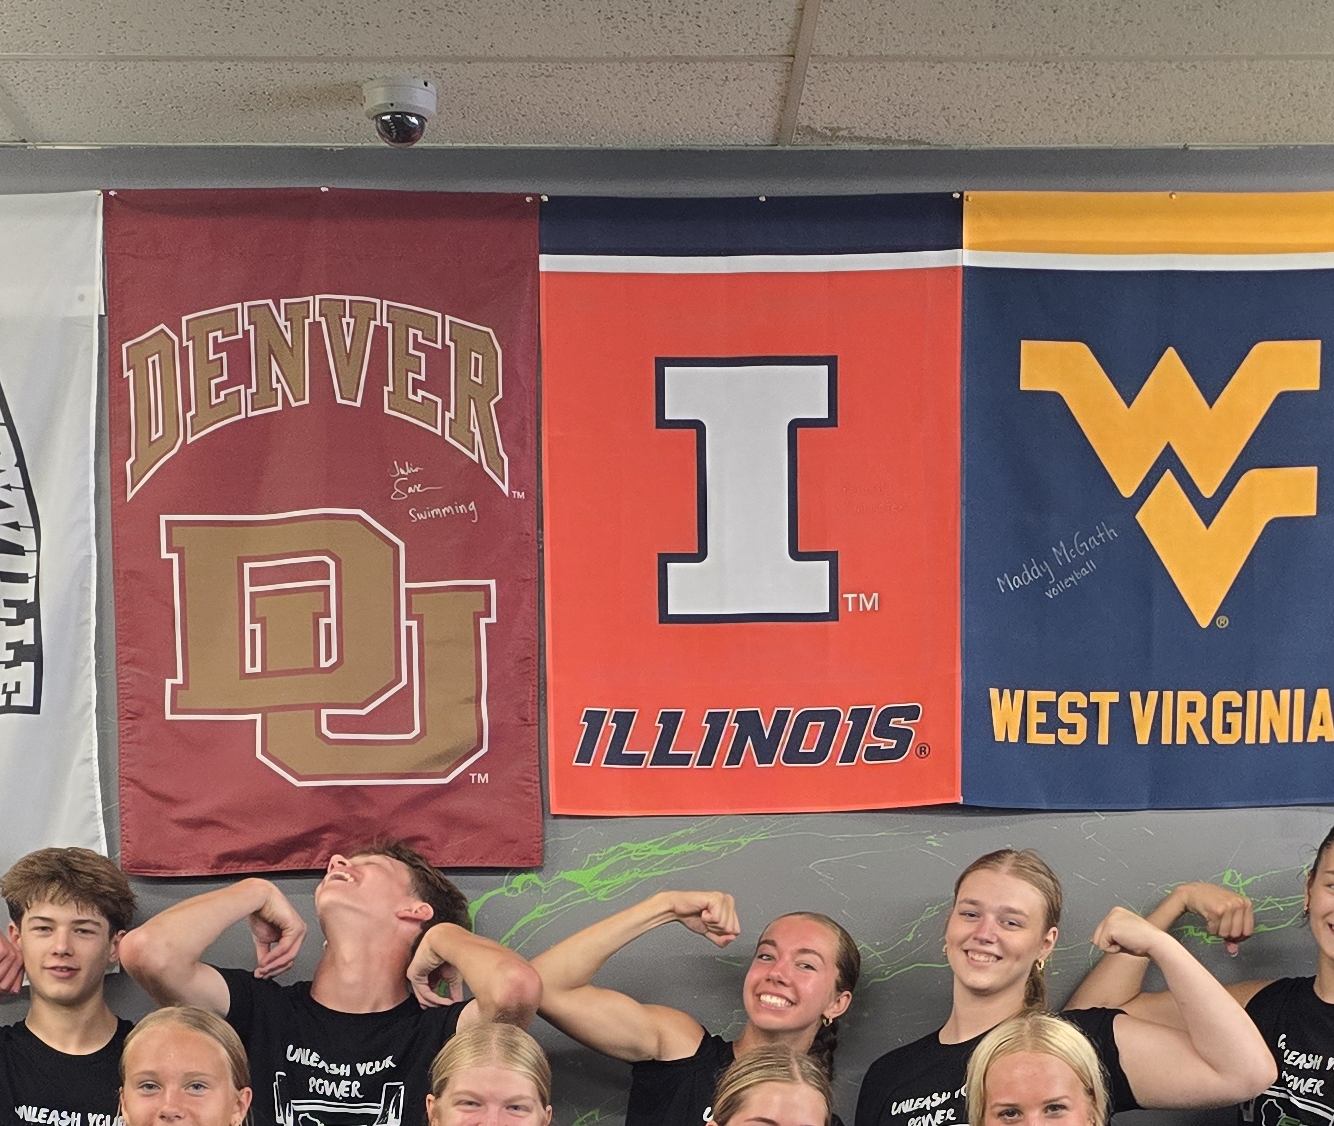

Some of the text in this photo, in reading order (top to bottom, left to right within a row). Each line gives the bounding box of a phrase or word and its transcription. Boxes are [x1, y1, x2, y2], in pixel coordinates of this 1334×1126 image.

[122, 294, 525, 502] DENVER TM
[654, 354, 879, 624] I TM
[408, 500, 478, 523] Swimming
[996, 557, 1056, 594] Maddy
[1044, 559, 1097, 599] volleyball
[989, 687, 1119, 746] WEST
[572, 703, 923, 769] ILLINOIS
[469, 773, 489, 784] TM
[286, 1044, 351, 1077] UNLEASH
[308, 1076, 365, 1099] POWER
